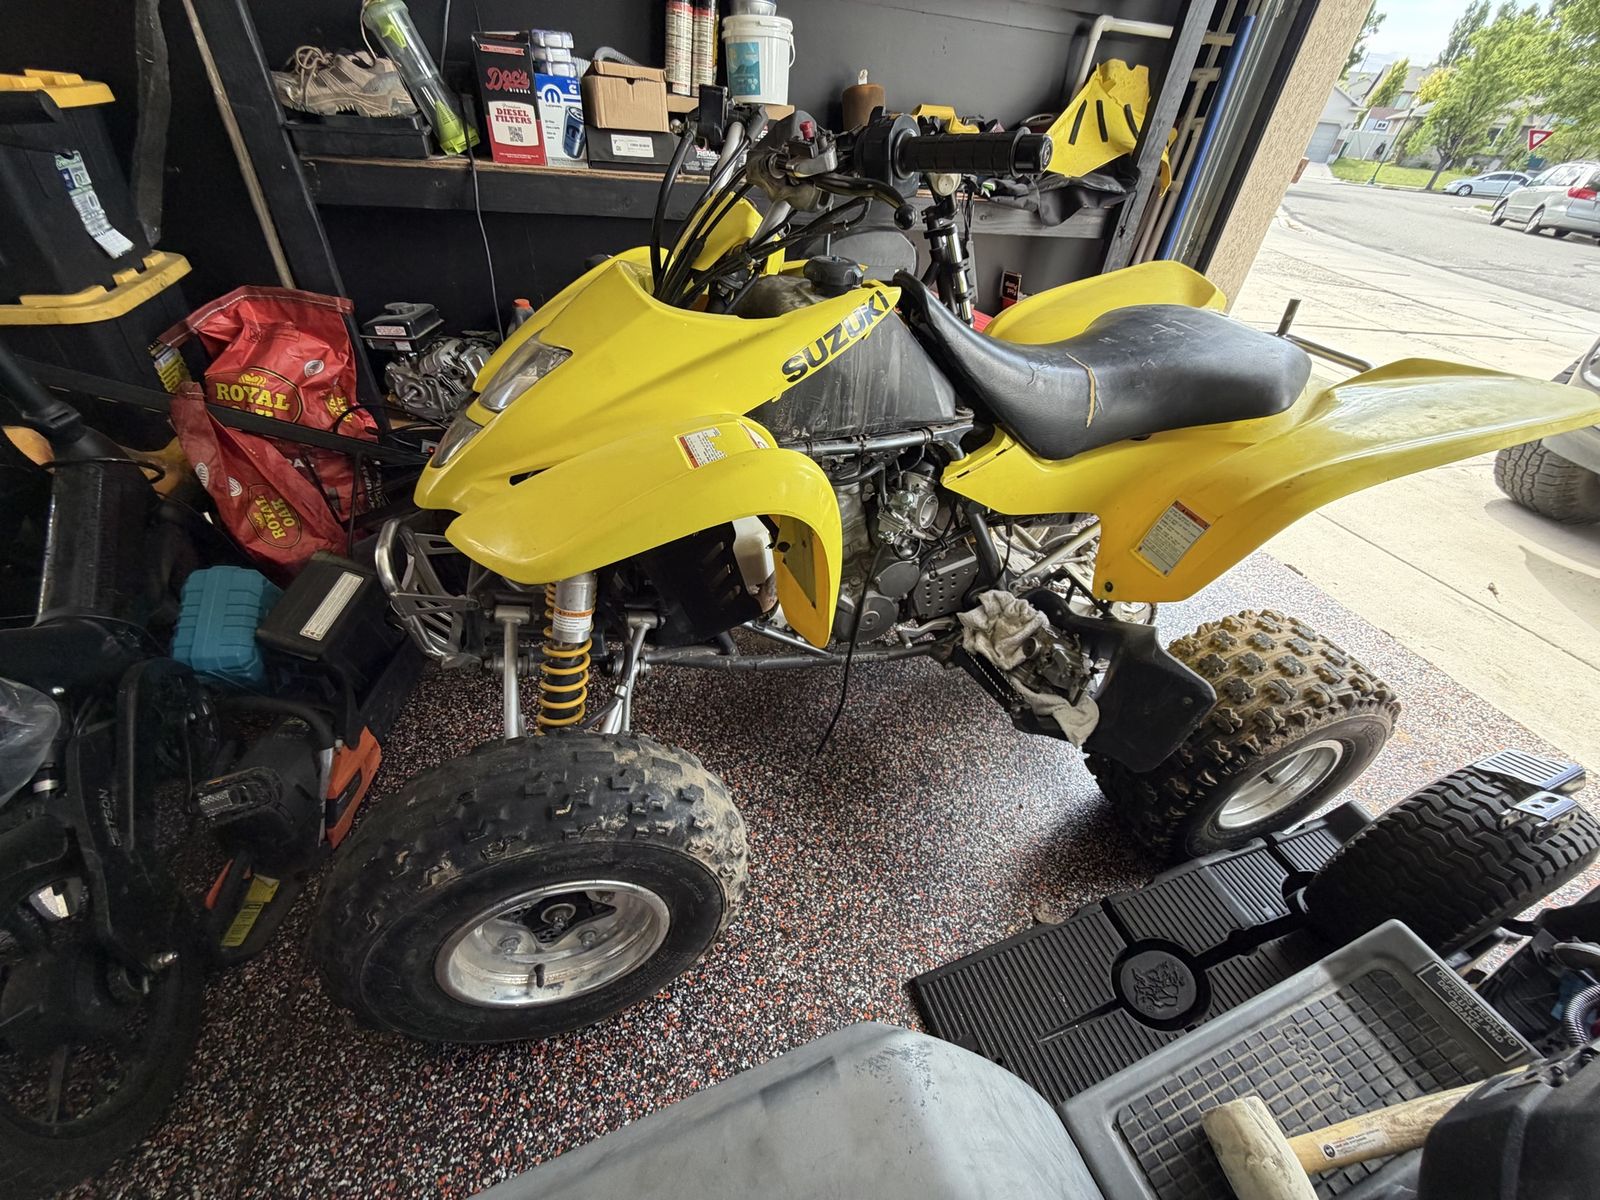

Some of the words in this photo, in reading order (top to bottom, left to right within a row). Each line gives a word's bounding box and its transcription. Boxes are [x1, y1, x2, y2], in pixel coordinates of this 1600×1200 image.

[495, 115, 532, 125] FILTERS
[496, 108, 529, 117] DIESEL
[781, 290, 890, 383] SUZUKI
[215, 383, 291, 411] ROYAL
[255, 495, 286, 539] ROYAL
[271, 498, 296, 527] OAK
[1436, 970, 1475, 1006] DEPRESS
[1474, 1006, 1502, 1033] PEDAL
[1503, 1032, 1517, 1047] TO
[1437, 980, 1484, 1023] DECLUTCH
[1482, 1025, 1504, 1043] AND
[1449, 1000, 1480, 1029] BRAKE
